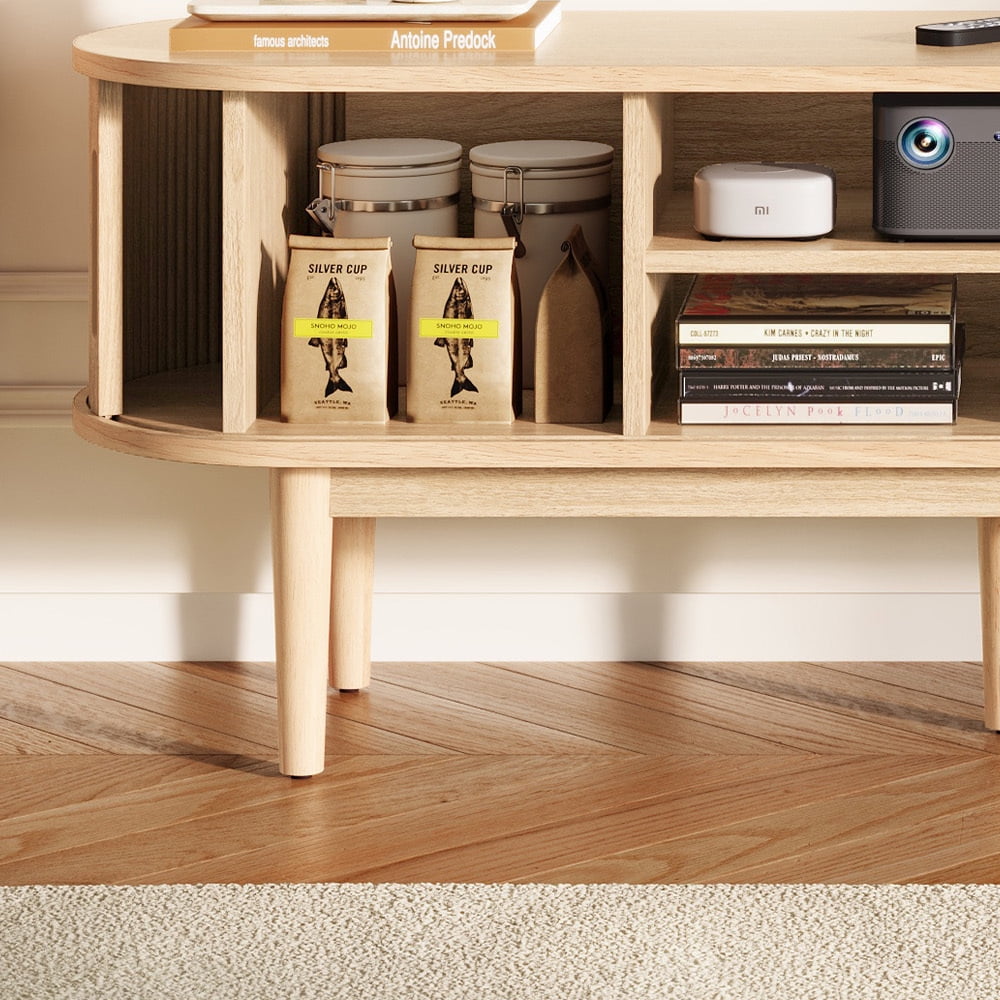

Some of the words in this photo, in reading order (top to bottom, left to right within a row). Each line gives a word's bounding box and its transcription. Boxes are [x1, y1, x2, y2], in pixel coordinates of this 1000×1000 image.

[253, 34, 285, 48] famous
[288, 34, 329, 48] architects
[390, 30, 440, 49] Antoine
[443, 30, 496, 49] Predock
[308, 264, 343, 273] SILVER
[346, 264, 368, 274] CUP
[434, 264, 469, 273] SILVER
[472, 264, 493, 274] CUP
[764, 329, 776, 337] KIM
[778, 329, 802, 337] CARNES
[811, 329, 831, 337] CRAZY
[832, 329, 839, 337] IN
[842, 329, 853, 337] THE
[855, 329, 874, 337] NIGHT
[772, 354, 790, 362] JUDAS
